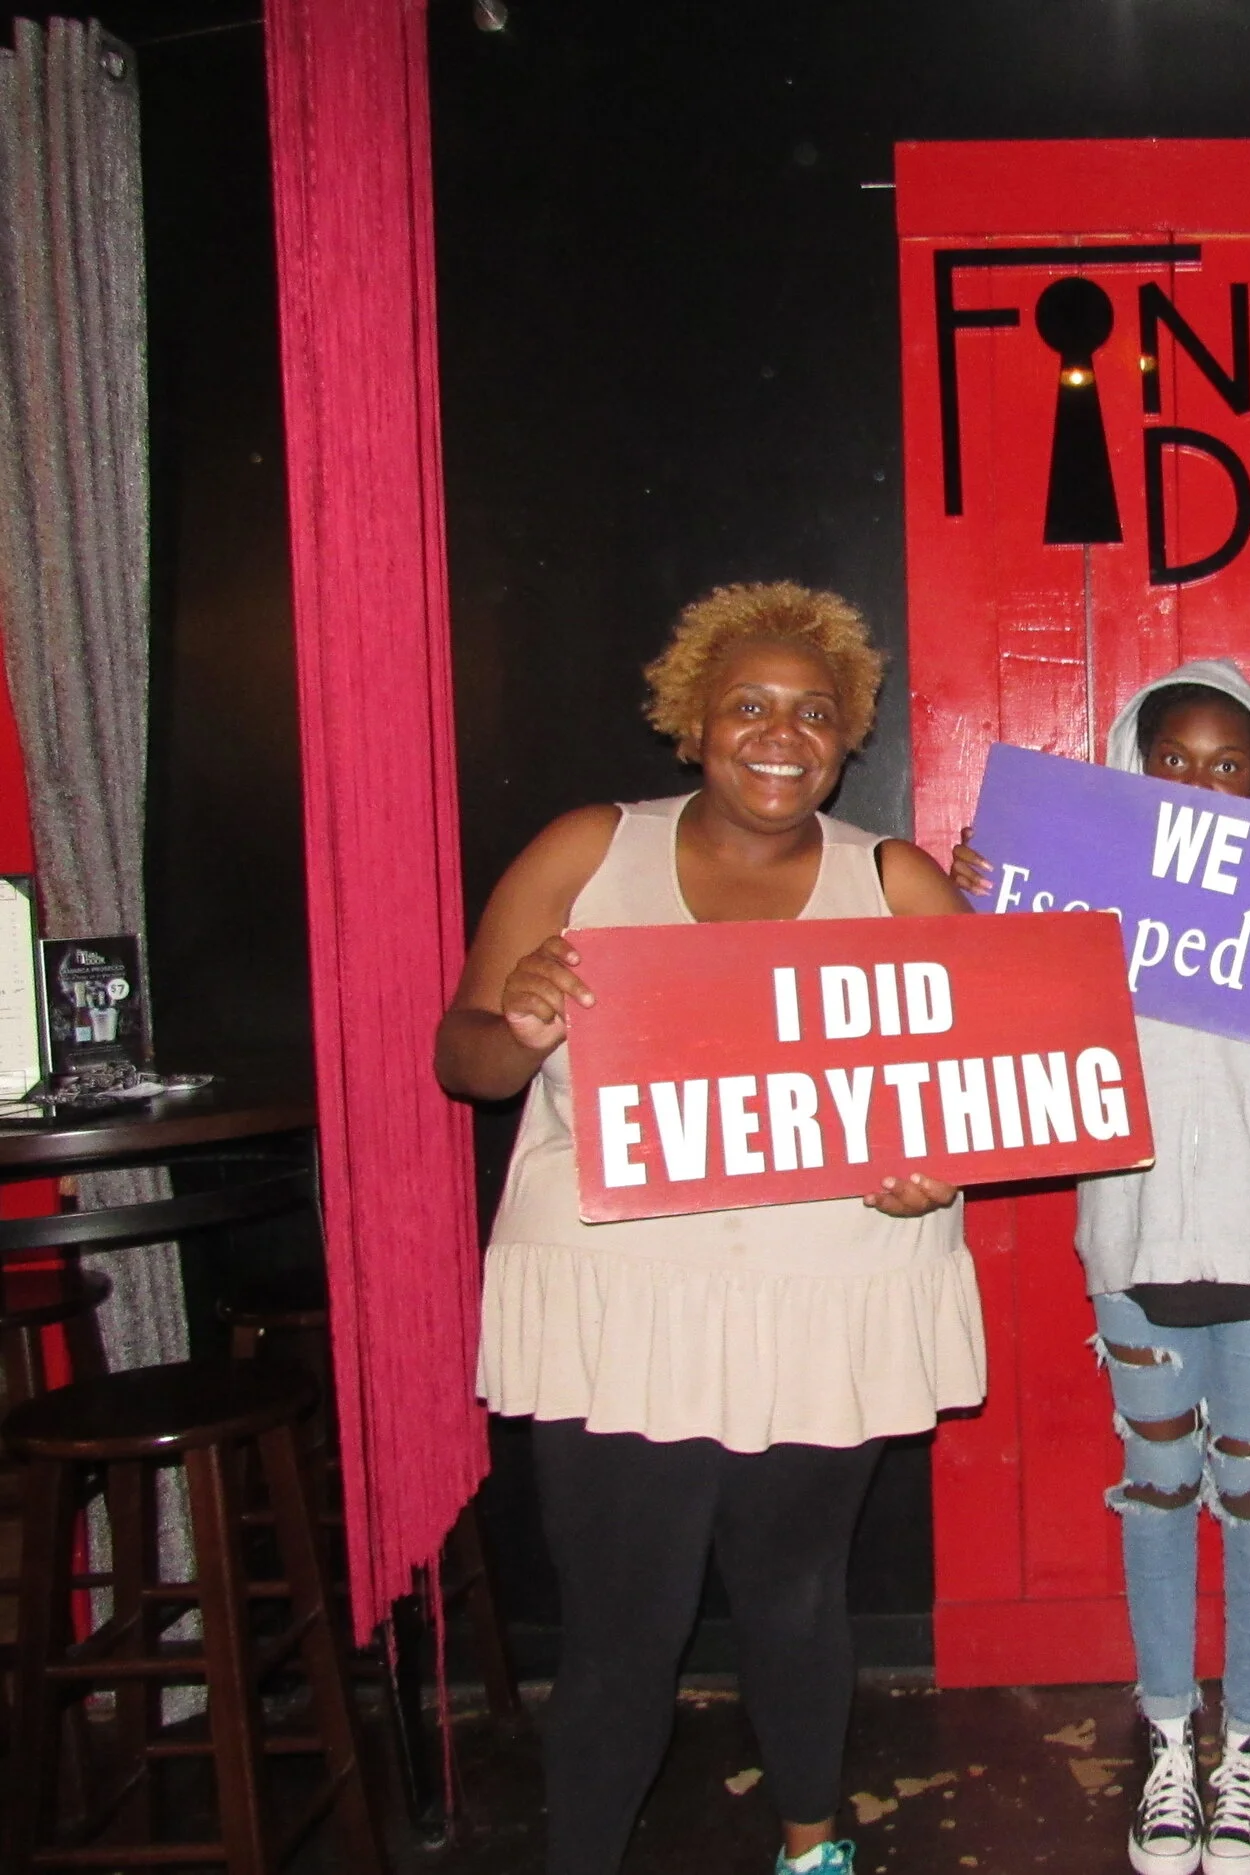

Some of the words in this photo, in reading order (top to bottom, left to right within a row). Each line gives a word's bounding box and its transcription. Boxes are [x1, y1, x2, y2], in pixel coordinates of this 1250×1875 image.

[1151, 801, 1250, 896] WE
[773, 967, 802, 1043] I
[820, 962, 954, 1041] DID
[599, 1047, 1131, 1188] EVERYTHING
